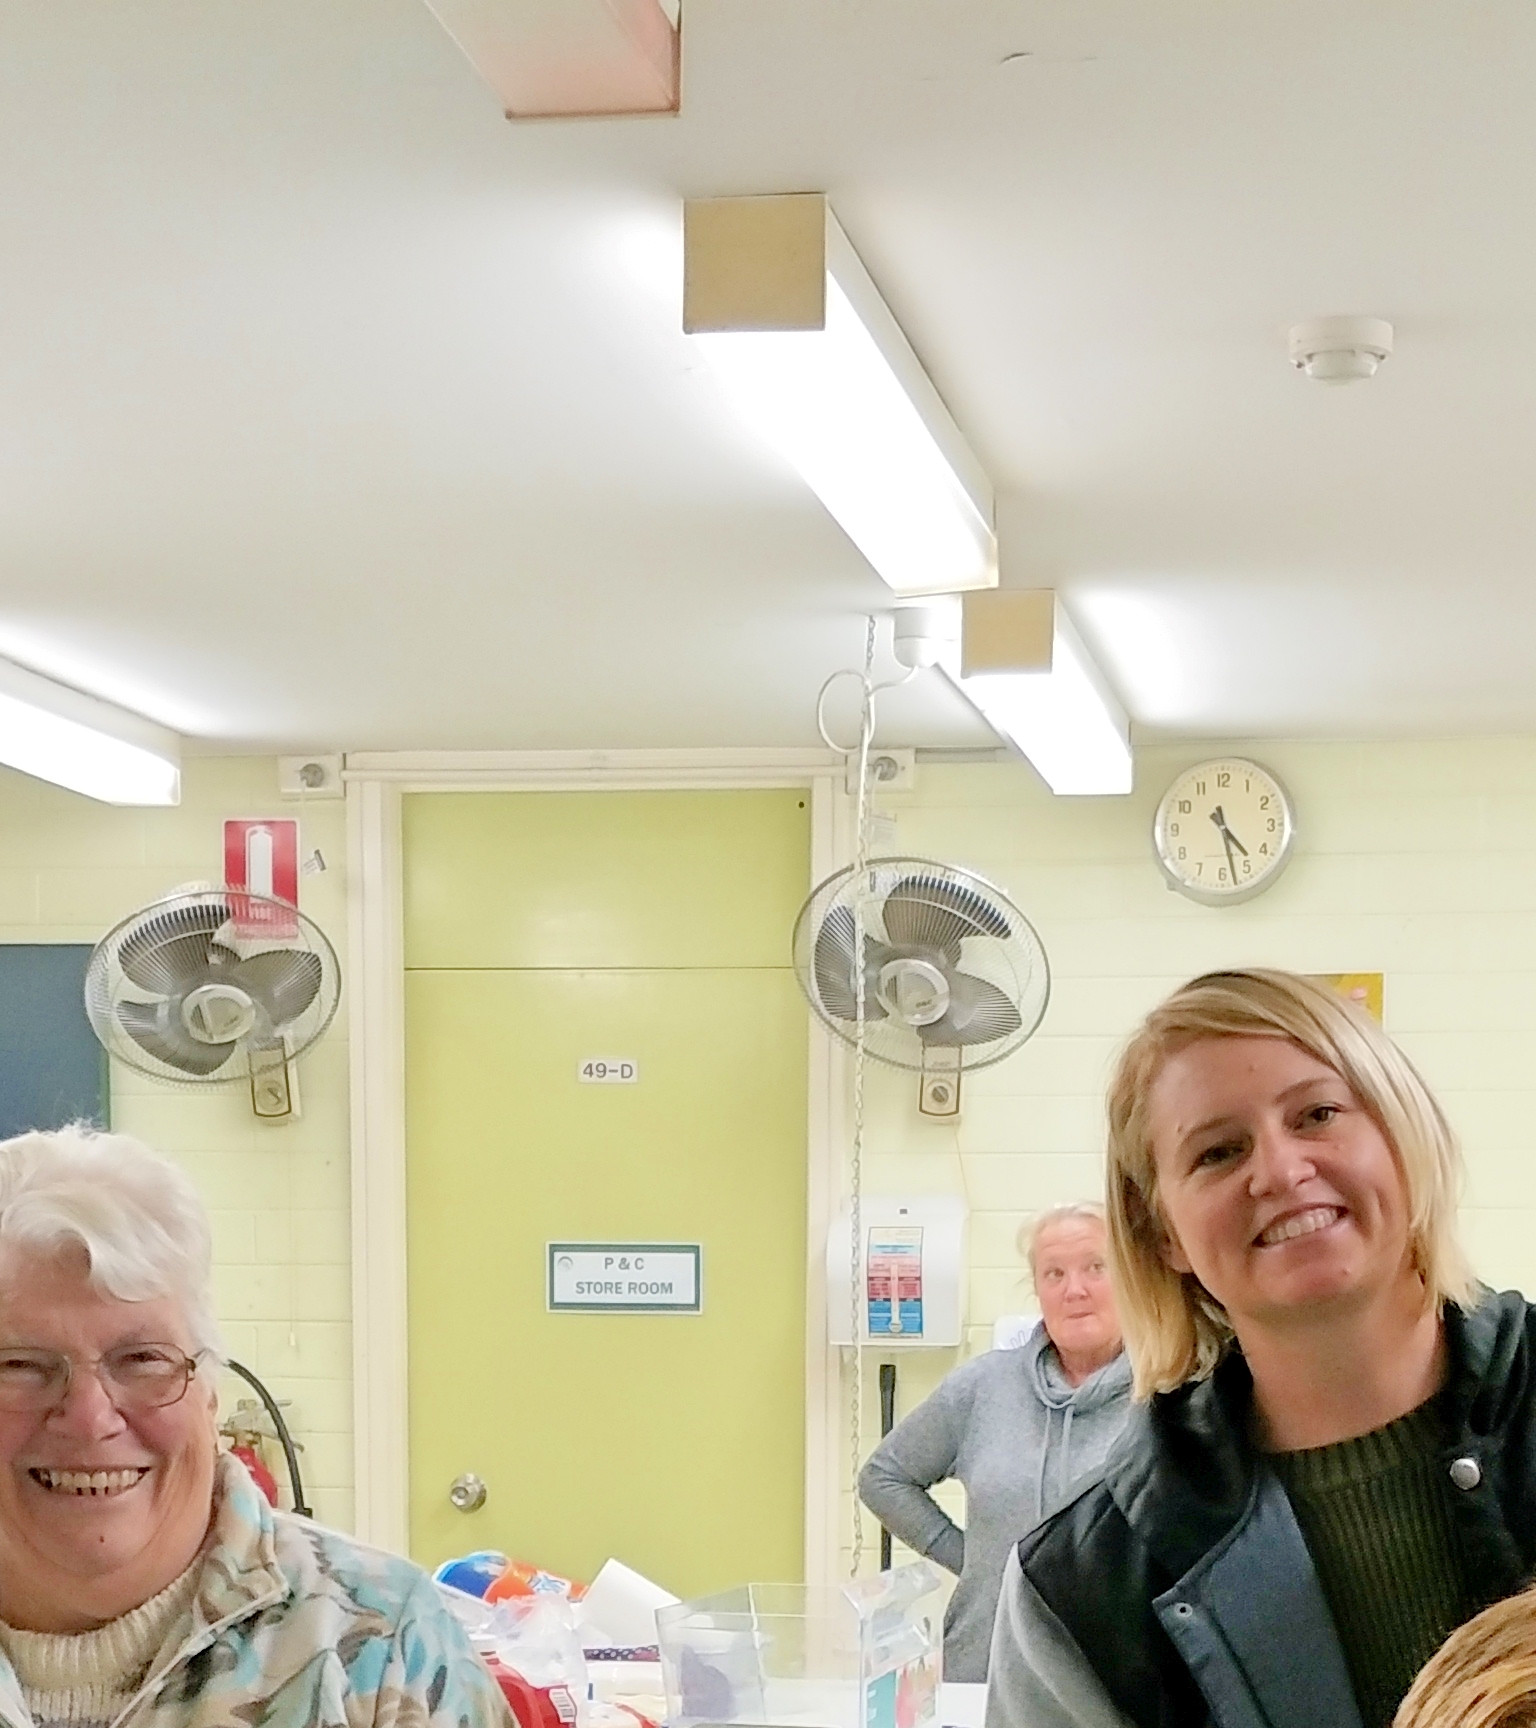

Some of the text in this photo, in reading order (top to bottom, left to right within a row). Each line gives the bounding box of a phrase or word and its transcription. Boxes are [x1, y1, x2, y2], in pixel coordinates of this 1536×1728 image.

[1217, 773, 1231, 788] 12
[1245, 779, 1250, 793] 1
[1196, 781, 1206, 795] 11
[1178, 800, 1192, 814] 10
[1260, 796, 1269, 810] 2
[1170, 823, 1179, 837] 9
[1266, 818, 1276, 832] 3
[1178, 846, 1187, 860] 8
[1259, 842, 1268, 856] 4
[1195, 862, 1203, 876] 7
[1218, 867, 1227, 881] 6
[1242, 860, 1251, 874] 5
[581, 1062, 634, 1079] 49-D
[604, 1257, 645, 1270] P & C
[575, 1281, 674, 1296] STORE ROOM
